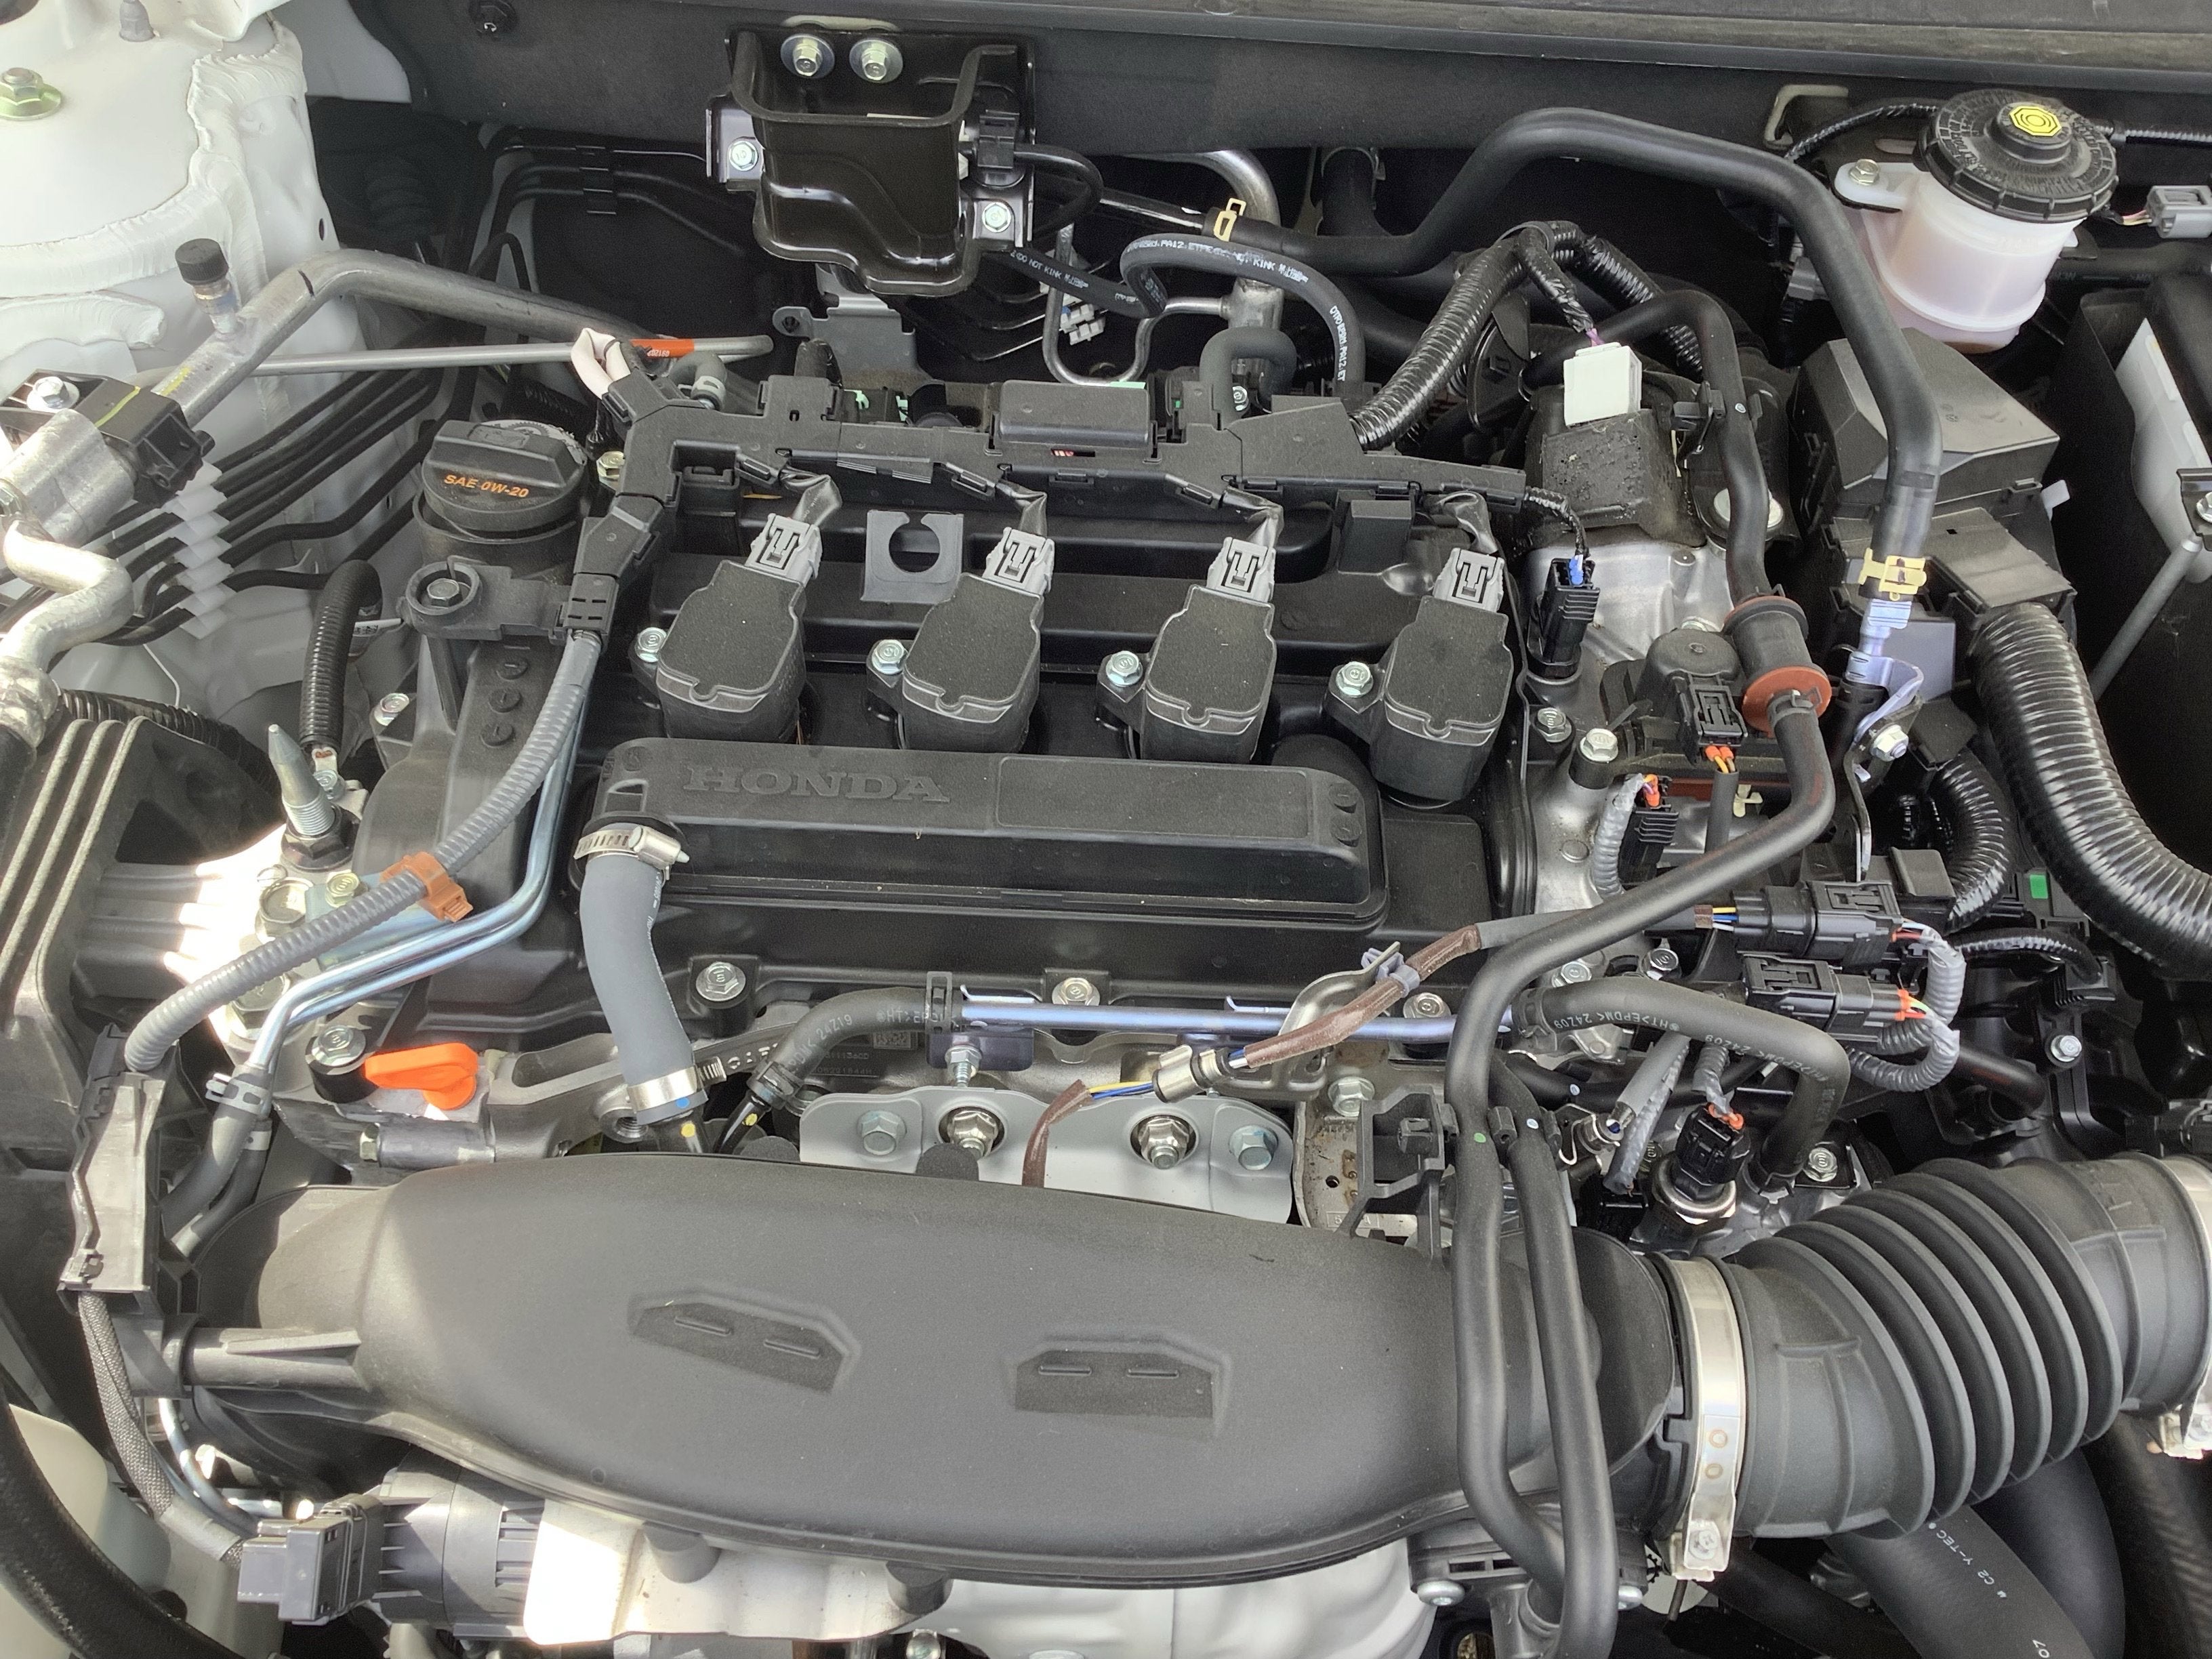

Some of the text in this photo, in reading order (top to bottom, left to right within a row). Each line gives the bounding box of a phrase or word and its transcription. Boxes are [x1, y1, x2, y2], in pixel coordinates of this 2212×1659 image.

[1044, 265, 1063, 279] KINK
[444, 474, 529, 497] SAE 0W-20
[683, 766, 949, 802] HONDA
[816, 1014, 853, 1040] 24Z19
[1553, 1013, 1593, 1029] 24Z09
[1936, 1530, 1973, 1565] Y-TEC
